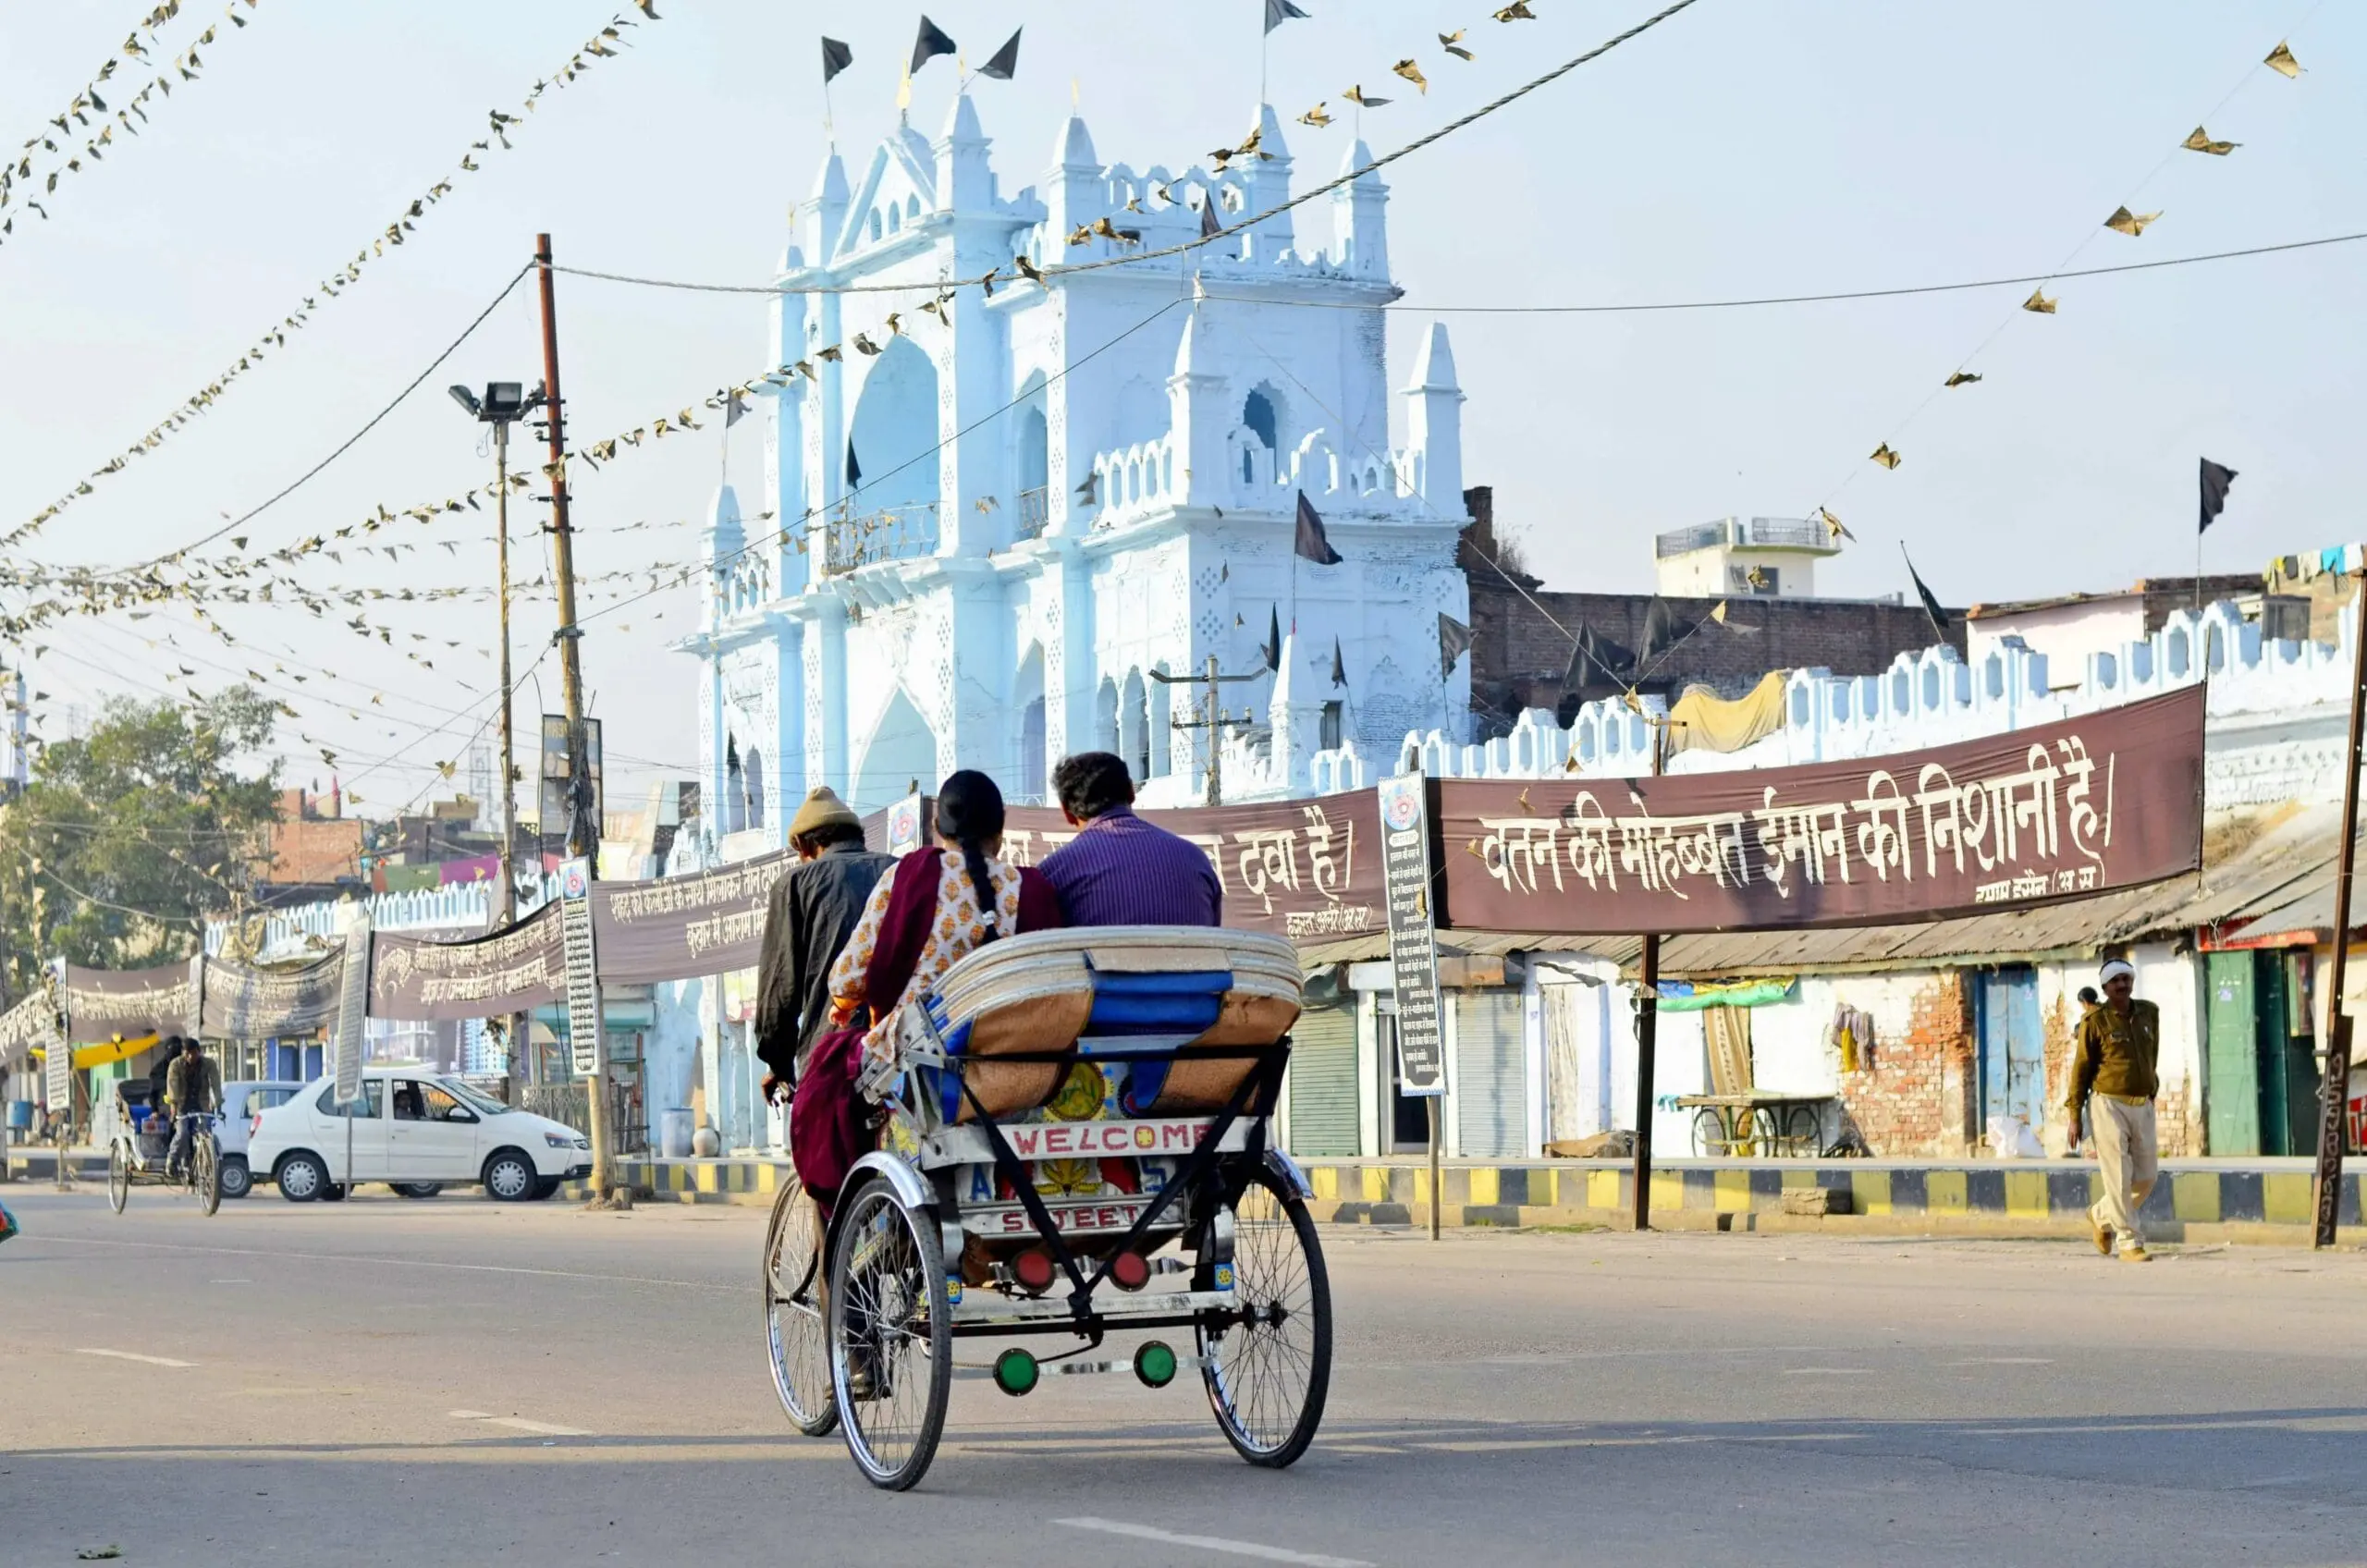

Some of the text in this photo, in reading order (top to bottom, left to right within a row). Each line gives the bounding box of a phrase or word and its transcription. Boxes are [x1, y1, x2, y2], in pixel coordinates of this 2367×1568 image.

[1479, 816, 1564, 896] वतन
[1565, 790, 1618, 893] की
[1615, 791, 1750, 900] मोहब्बत
[1751, 785, 1849, 899] ईमान
[1850, 769, 1912, 884] की
[1913, 742, 2063, 878] निशानी
[1233, 828, 1301, 916] दवा
[1012, 1123, 1215, 1155] WELCOME
